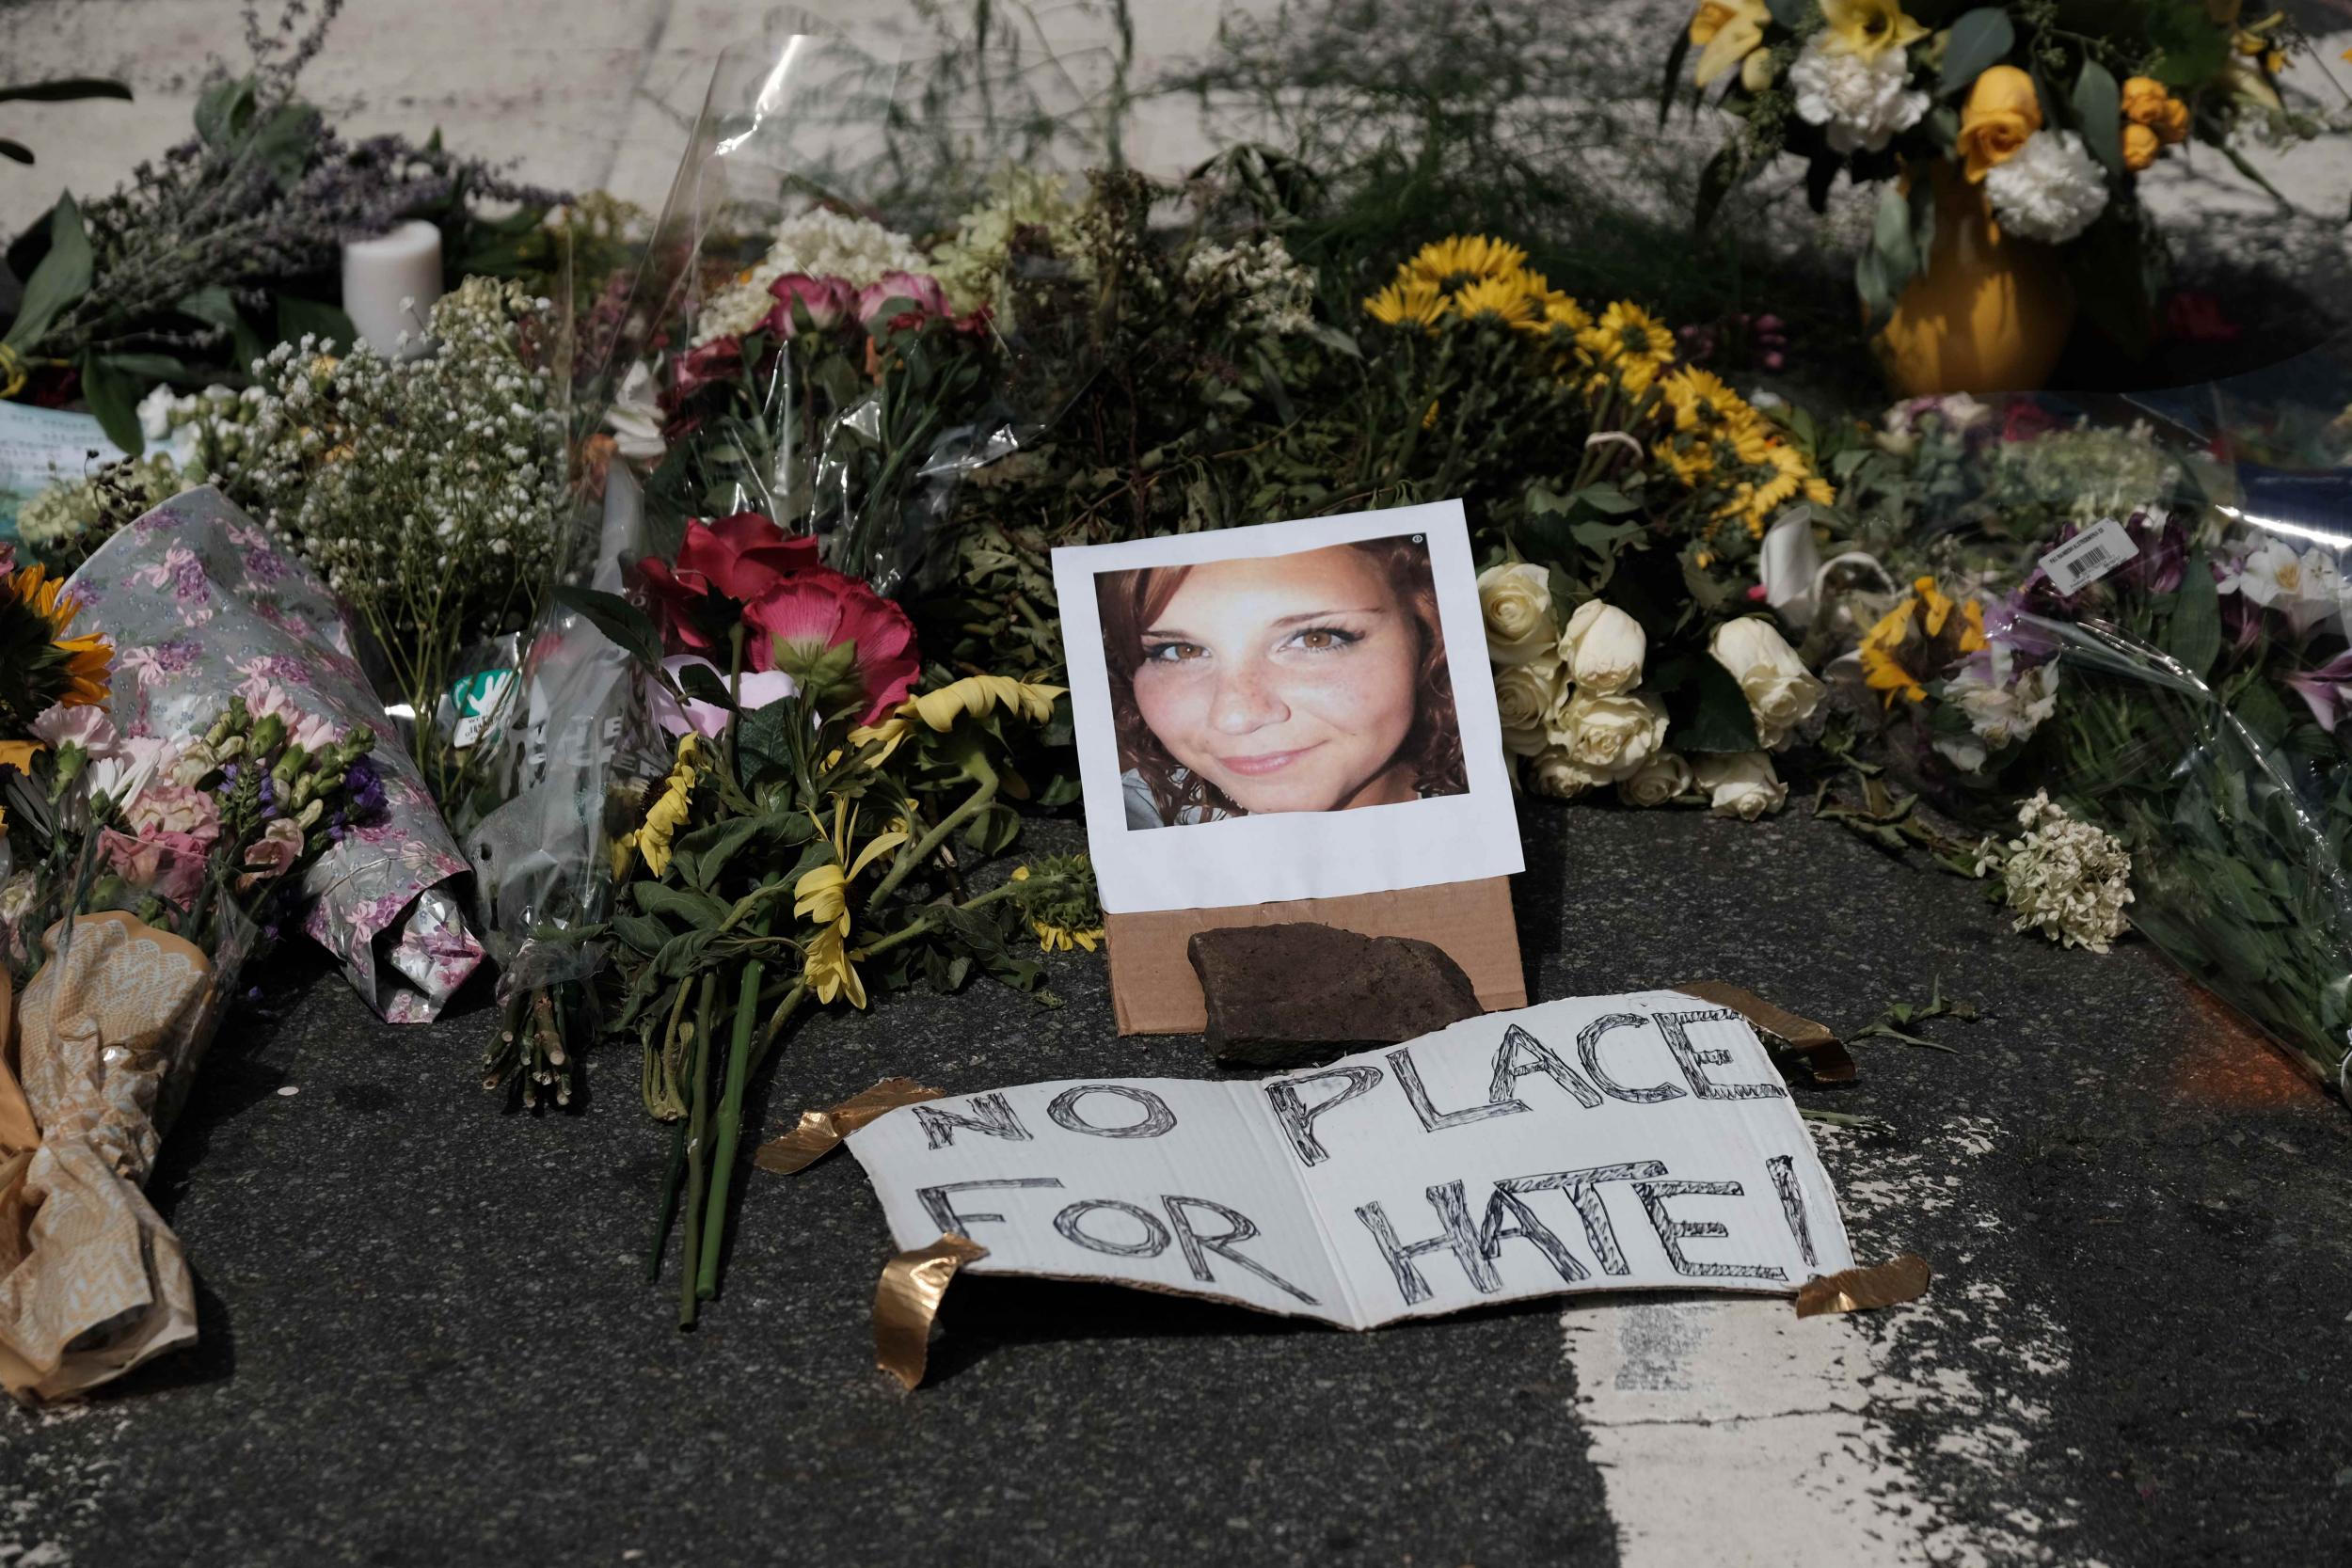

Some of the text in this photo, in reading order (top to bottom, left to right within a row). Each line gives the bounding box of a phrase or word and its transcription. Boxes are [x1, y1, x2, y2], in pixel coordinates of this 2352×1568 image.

[912, 1008, 1788, 1167] NO PLACE
[915, 1155, 1823, 1306] FOR HATE!
